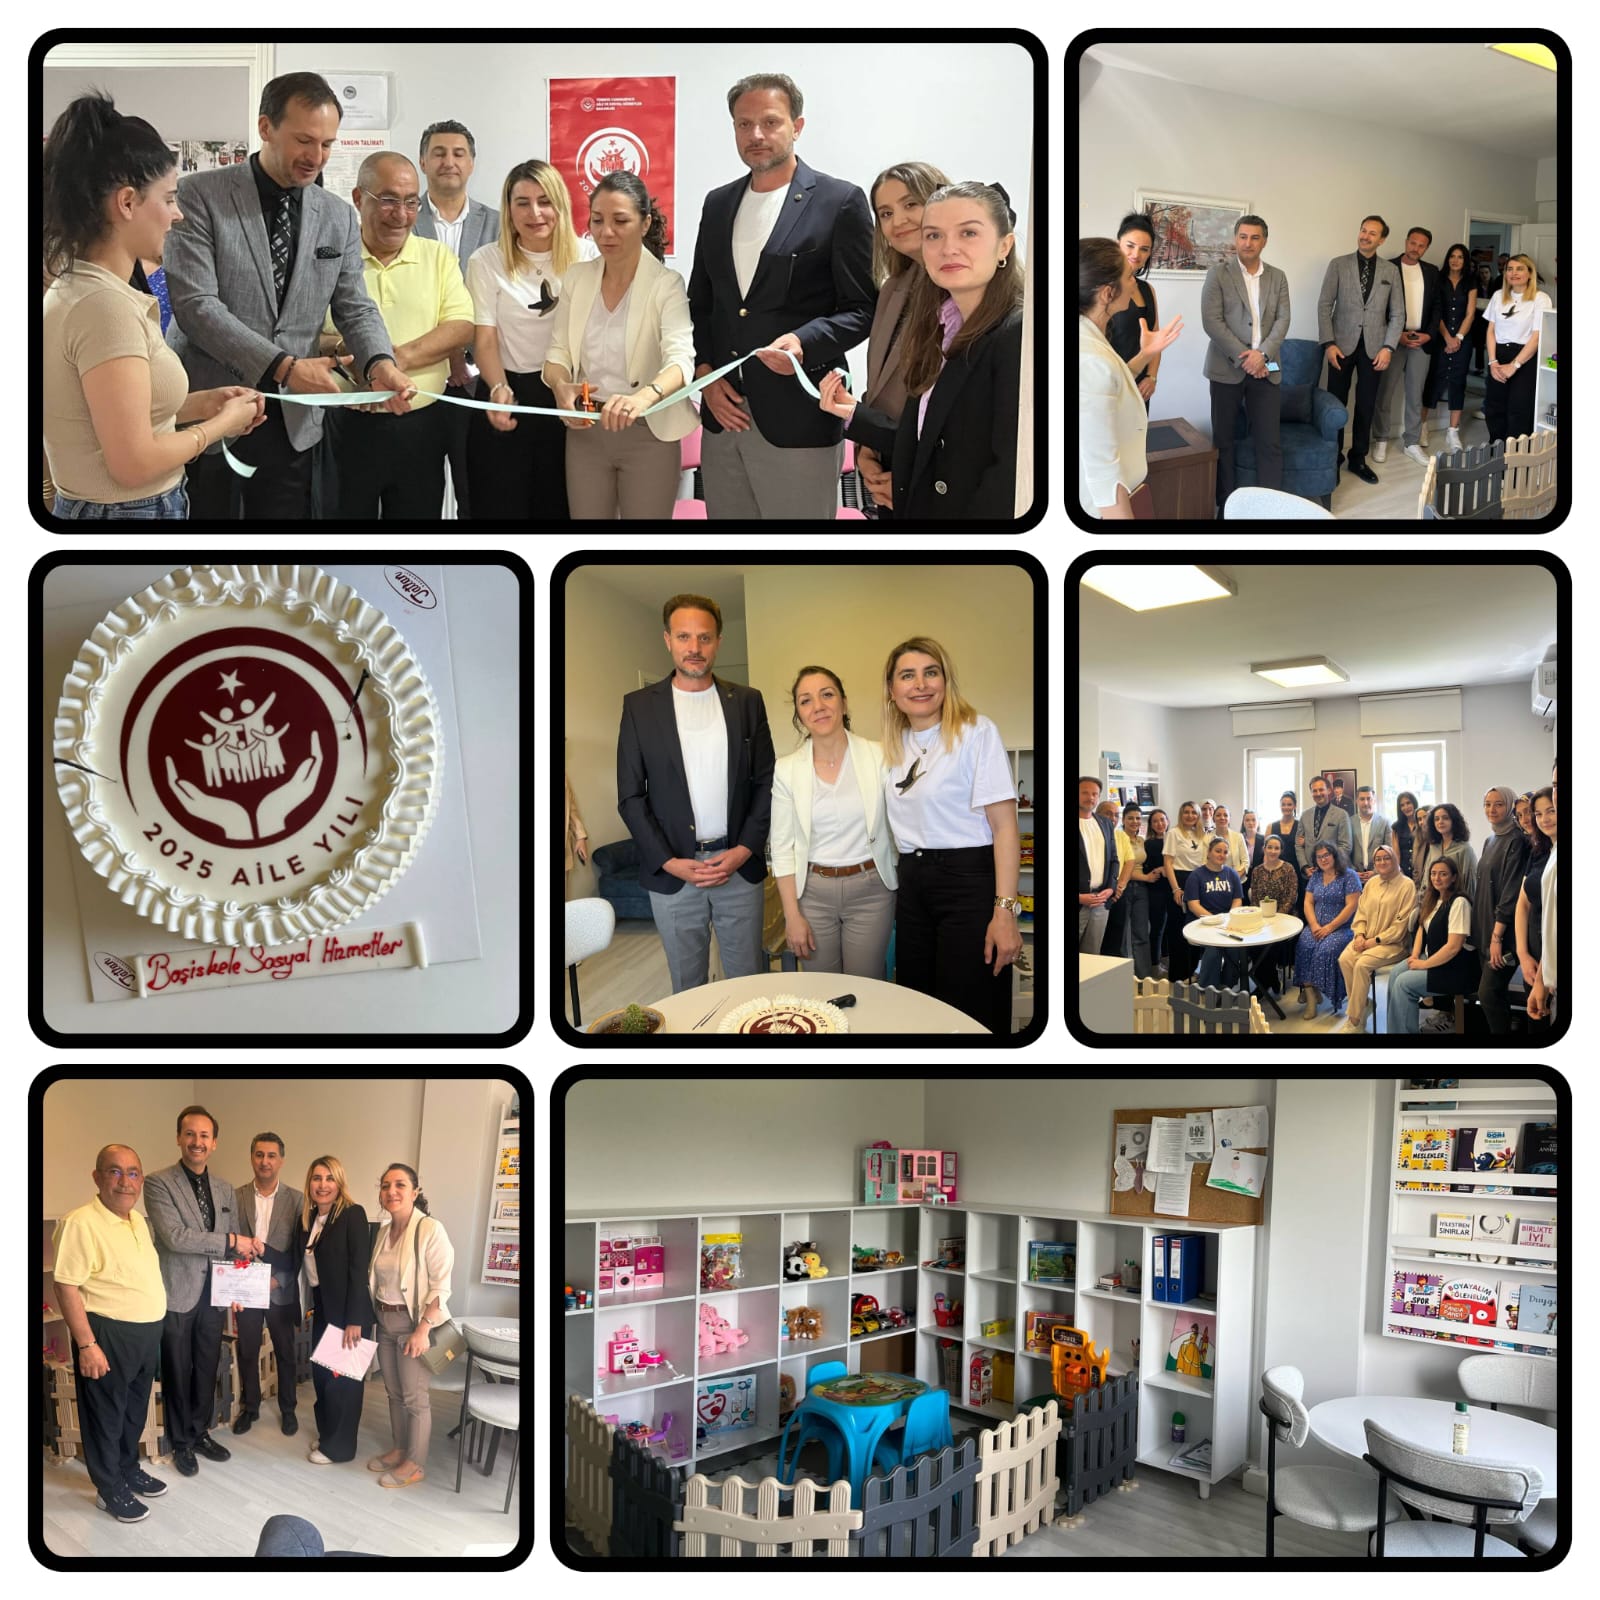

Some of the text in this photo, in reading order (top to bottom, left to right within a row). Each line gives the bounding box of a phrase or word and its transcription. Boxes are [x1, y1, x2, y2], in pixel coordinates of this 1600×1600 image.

[142, 796, 364, 886] 2025 AİLE YILI
[244, 939, 312, 980] Sosyal
[321, 931, 403, 964] Hizmetler
[1412, 1296, 1430, 1305] SPOR
